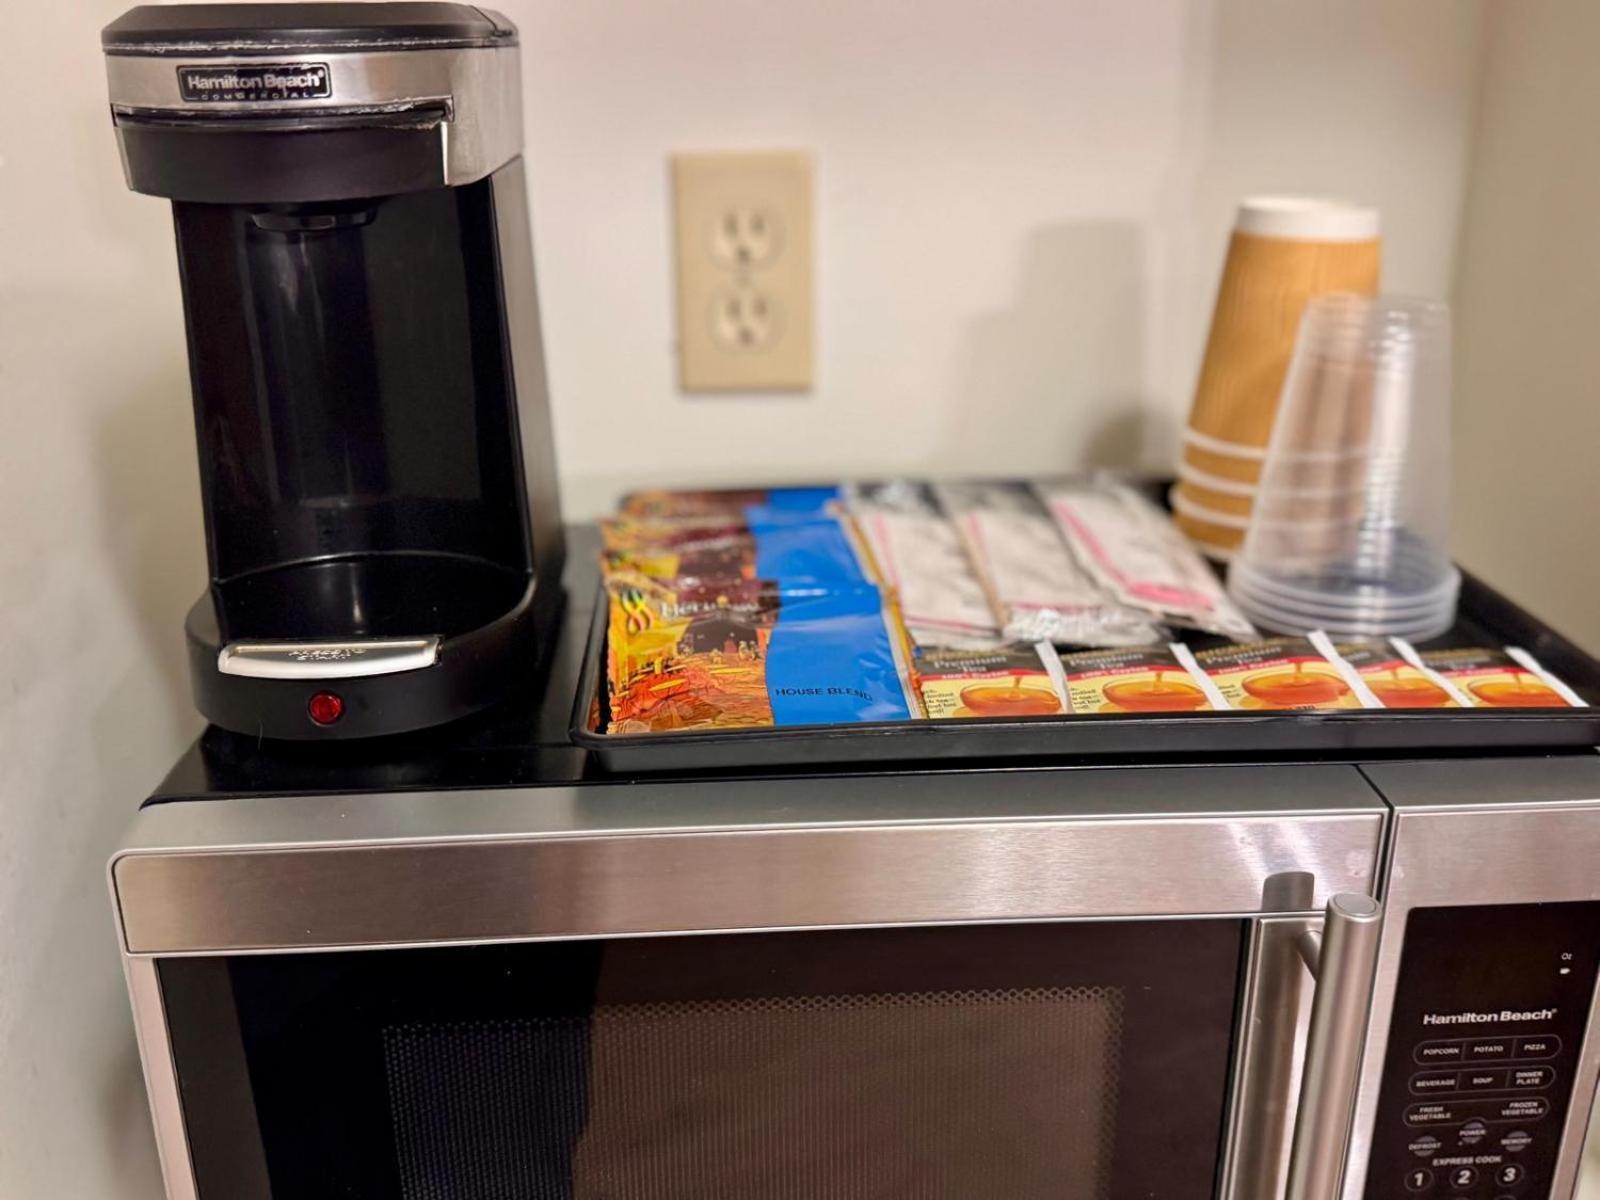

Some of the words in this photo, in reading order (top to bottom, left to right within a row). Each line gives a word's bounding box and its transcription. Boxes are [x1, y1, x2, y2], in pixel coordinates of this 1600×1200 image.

[187, 74, 262, 90] Hamilton
[263, 70, 322, 89] Beach
[775, 687, 824, 696] HOUSE
[827, 687, 873, 701] BLEND
[1423, 1012, 1498, 1025] Hamilton
[1500, 1009, 1554, 1022] Beach
[1423, 1047, 1460, 1056] POPCORN
[1474, 1045, 1504, 1053] POTATO
[1524, 1043, 1546, 1051] PIZZA
[1416, 1079, 1456, 1087] BEVERAGE
[1516, 1077, 1541, 1085] PLATE
[1409, 1113, 1451, 1121] VEGETABLE
[1432, 1156, 1474, 1166] EXPRESS
[1475, 1155, 1502, 1165] COOK
[1414, 1172, 1424, 1187] 1
[1457, 1170, 1471, 1184] 2
[1503, 1168, 1517, 1182] 3
